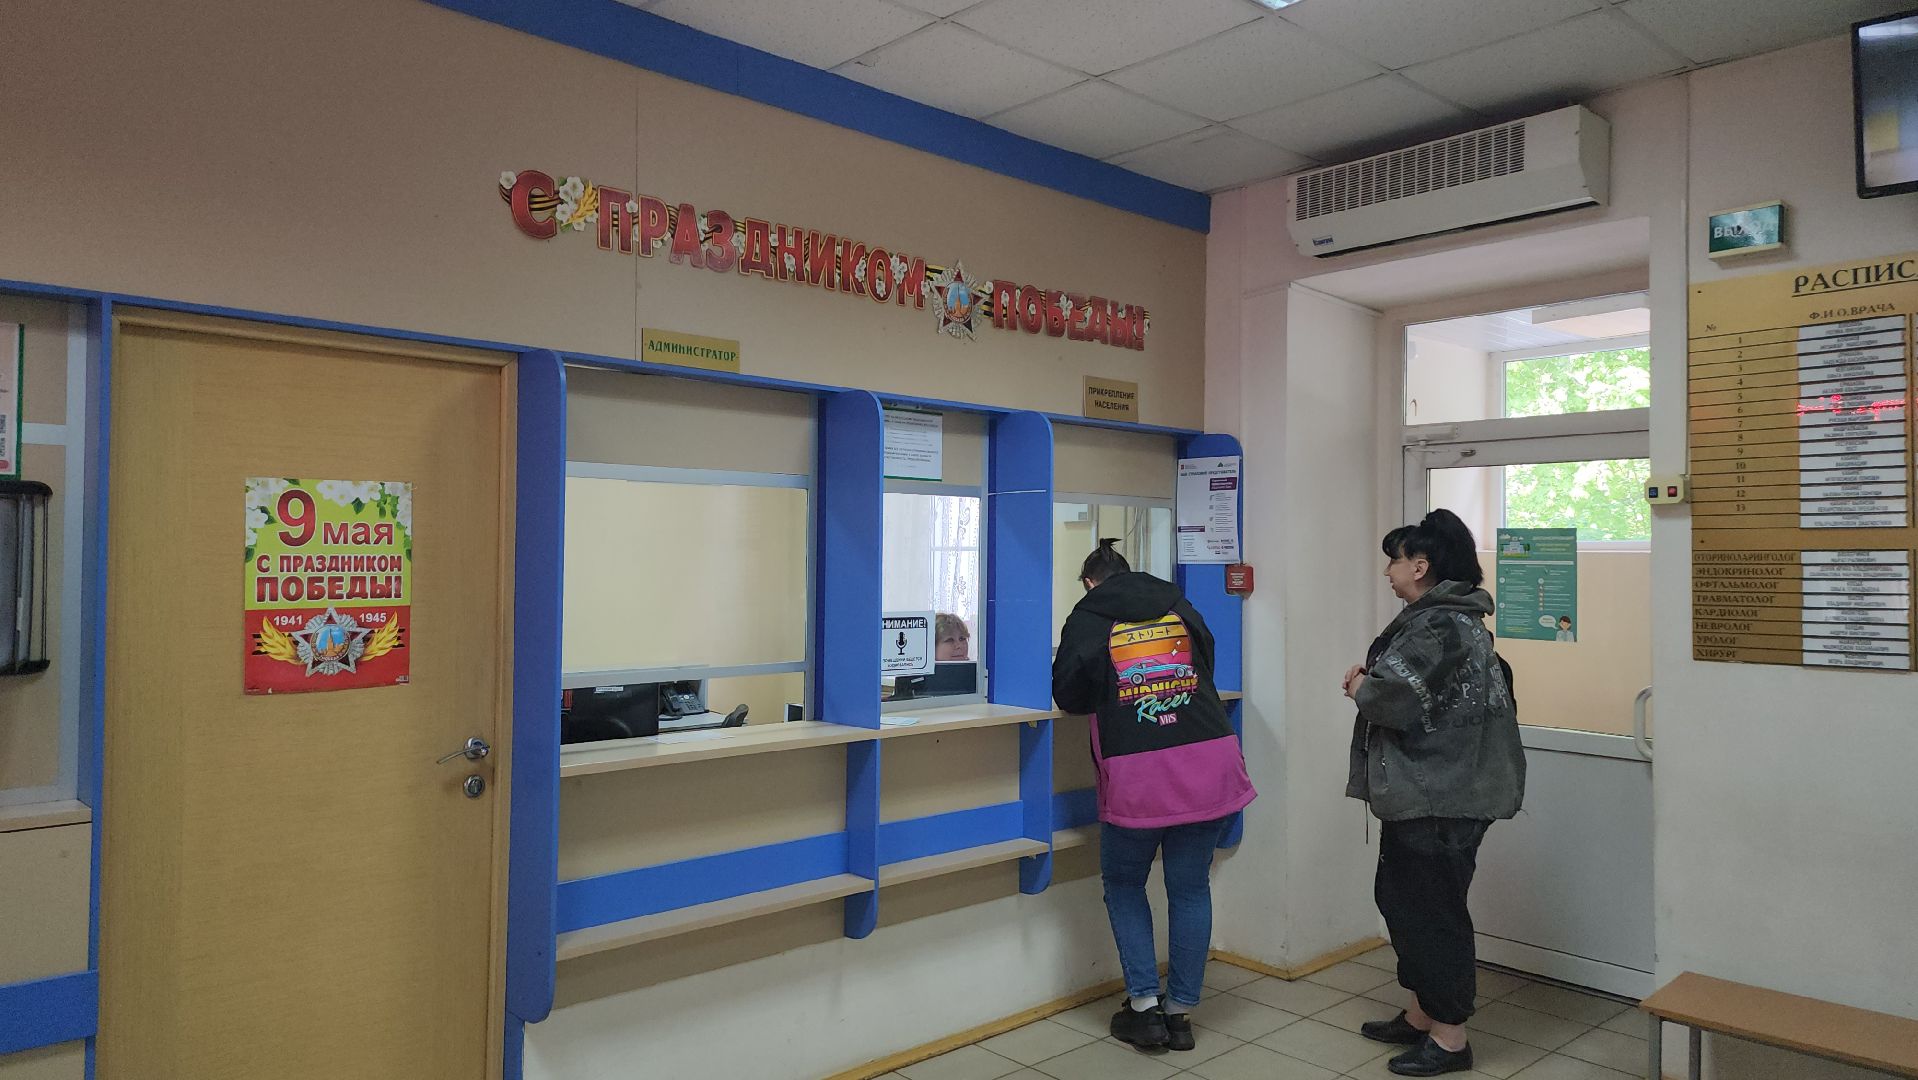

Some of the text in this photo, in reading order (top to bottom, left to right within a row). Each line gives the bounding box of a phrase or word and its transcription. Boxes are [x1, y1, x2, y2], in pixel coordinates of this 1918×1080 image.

[510, 169, 1146, 352] С ПРАЗДНИКОМ ПОБЕДЫ!
[1793, 260, 1918, 293] РАСПИС
[1737, 336, 1743, 344] 1
[647, 338, 738, 362] АДМИНИСТРАТОР
[1737, 350, 1743, 359] 2
[1737, 365, 1743, 373] 3
[1736, 378, 1743, 387] 4
[1088, 386, 1135, 400] ПРИКРЕПЛЕНИЕ
[1737, 392, 1743, 401] 5
[1094, 400, 1130, 411] НАСЕЛЕНИЯ
[1737, 406, 1743, 415] 6
[1737, 420, 1743, 428] 7
[1736, 433, 1743, 442] 8
[1736, 447, 1743, 456] 9
[1735, 461, 1746, 470] 10
[1736, 475, 1745, 483] 11
[1736, 489, 1746, 498] 12
[1735, 503, 1746, 512] 13
[276, 488, 394, 547] 9 мая
[256, 555, 403, 573] С ПРАЗДНИКОМ
[1695, 567, 1786, 577] ЭНДОКРИНОЛОГ
[256, 575, 403, 603] ПОБЕДЫ!
[1695, 581, 1779, 590] ОФТАЛЬМОЛОГ
[1696, 595, 1776, 604] ТРАВМАТОЛОГ
[1694, 608, 1760, 618] КАРДИОЛОГ
[273, 612, 387, 626] 1941 1945
[882, 619, 927, 629] НИМАНИЕ!
[1695, 622, 1753, 631] НЕВРОЛОГ
[1126, 626, 1172, 642] ストリート
[1696, 635, 1737, 645] УРОЛОГ
[1696, 649, 1737, 658] ХИРУРГ
[1118, 677, 1199, 702] MIDNIGHT
[1134, 692, 1192, 723] Racer
[1159, 713, 1178, 726] VHS
